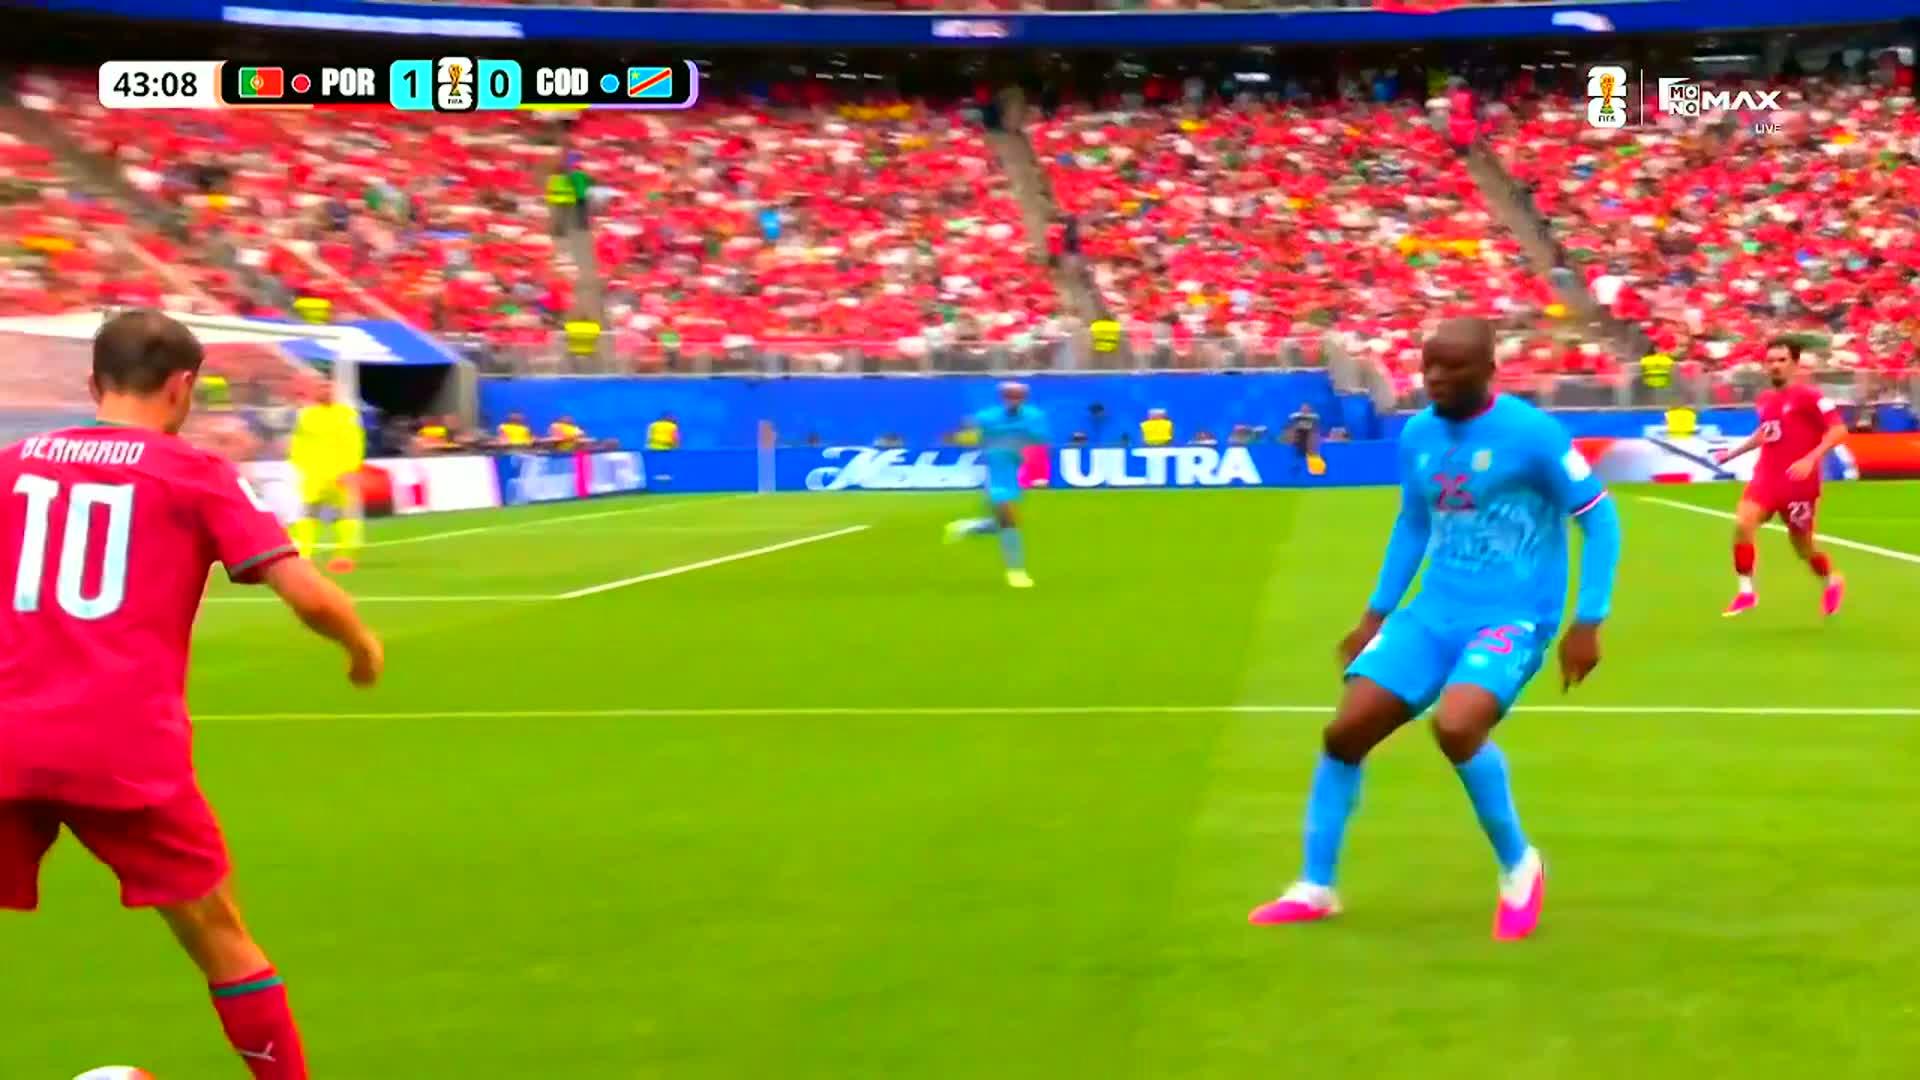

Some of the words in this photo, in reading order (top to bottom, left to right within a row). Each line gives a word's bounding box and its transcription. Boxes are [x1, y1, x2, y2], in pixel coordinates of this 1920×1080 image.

[20, 436, 145, 465] BERNARDO
[1060, 447, 1261, 486] ULTRA
[12, 473, 136, 620] 10
